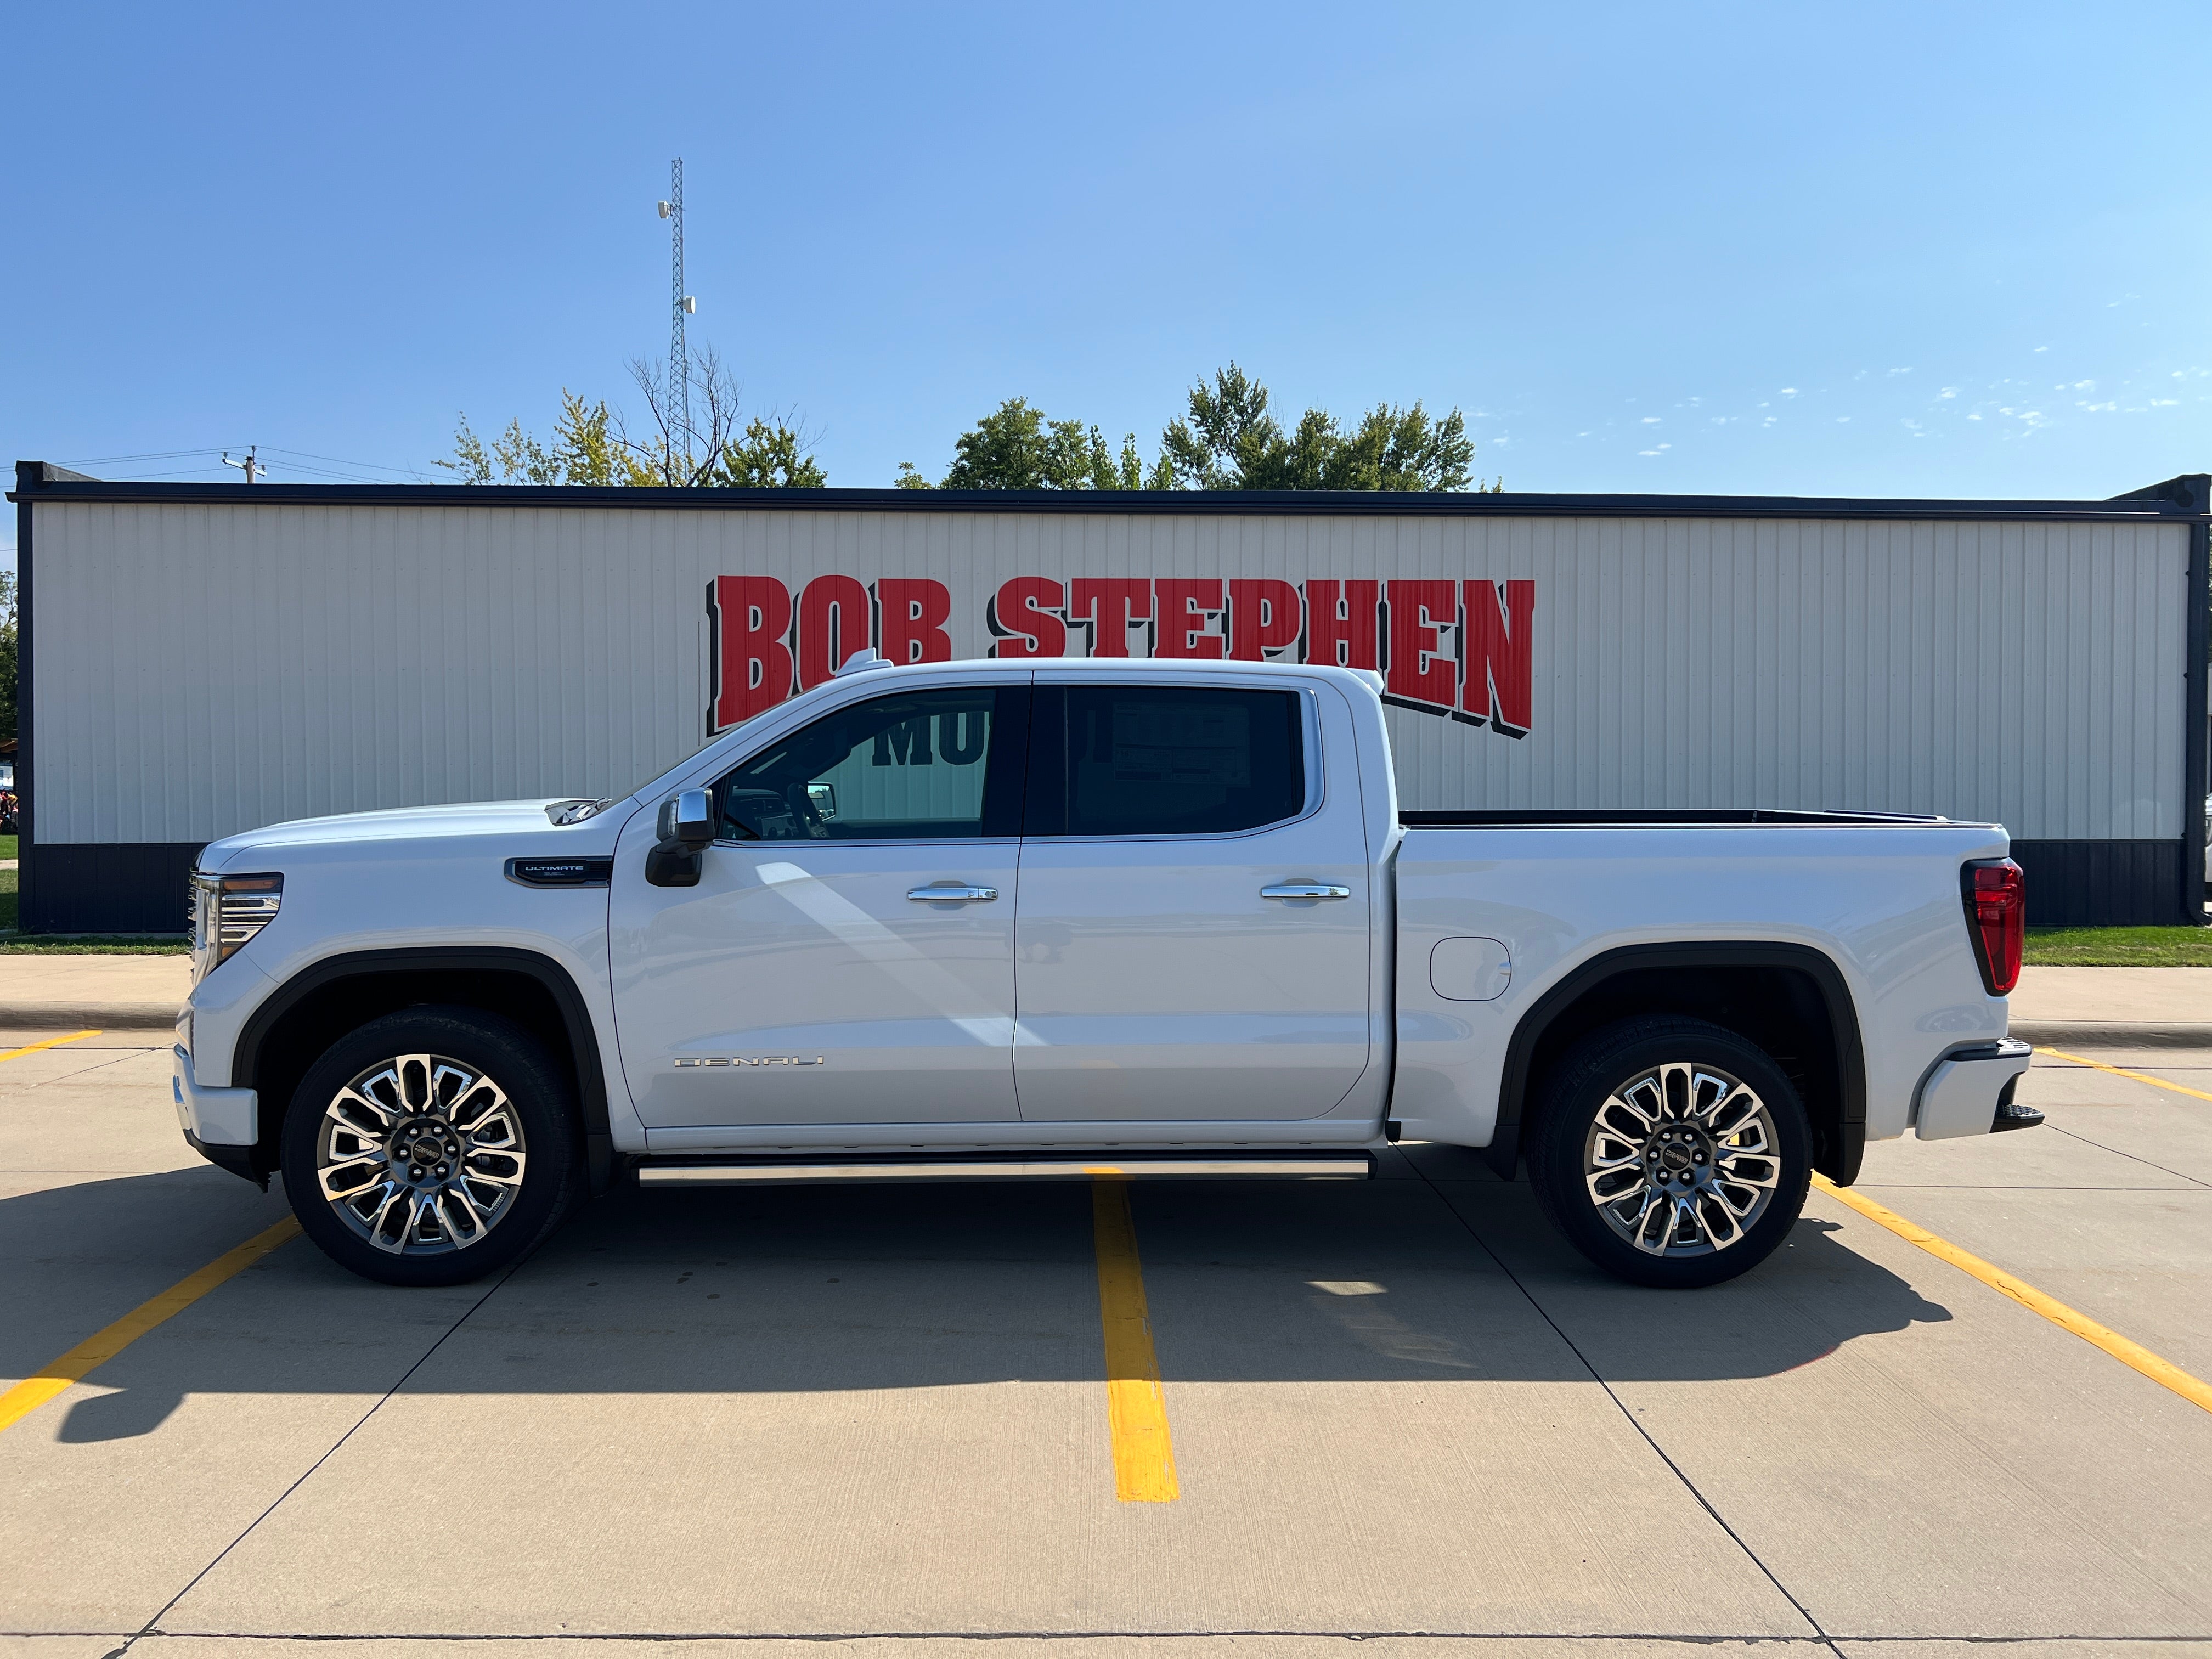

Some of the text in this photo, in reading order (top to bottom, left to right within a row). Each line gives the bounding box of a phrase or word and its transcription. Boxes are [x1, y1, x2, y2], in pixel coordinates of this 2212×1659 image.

[707, 575, 1536, 740] BOB STEPHEN
[674, 1055, 824, 1068] DENALI
[414, 1144, 439, 1158] GMC
[1665, 1149, 1688, 1164] GMC
